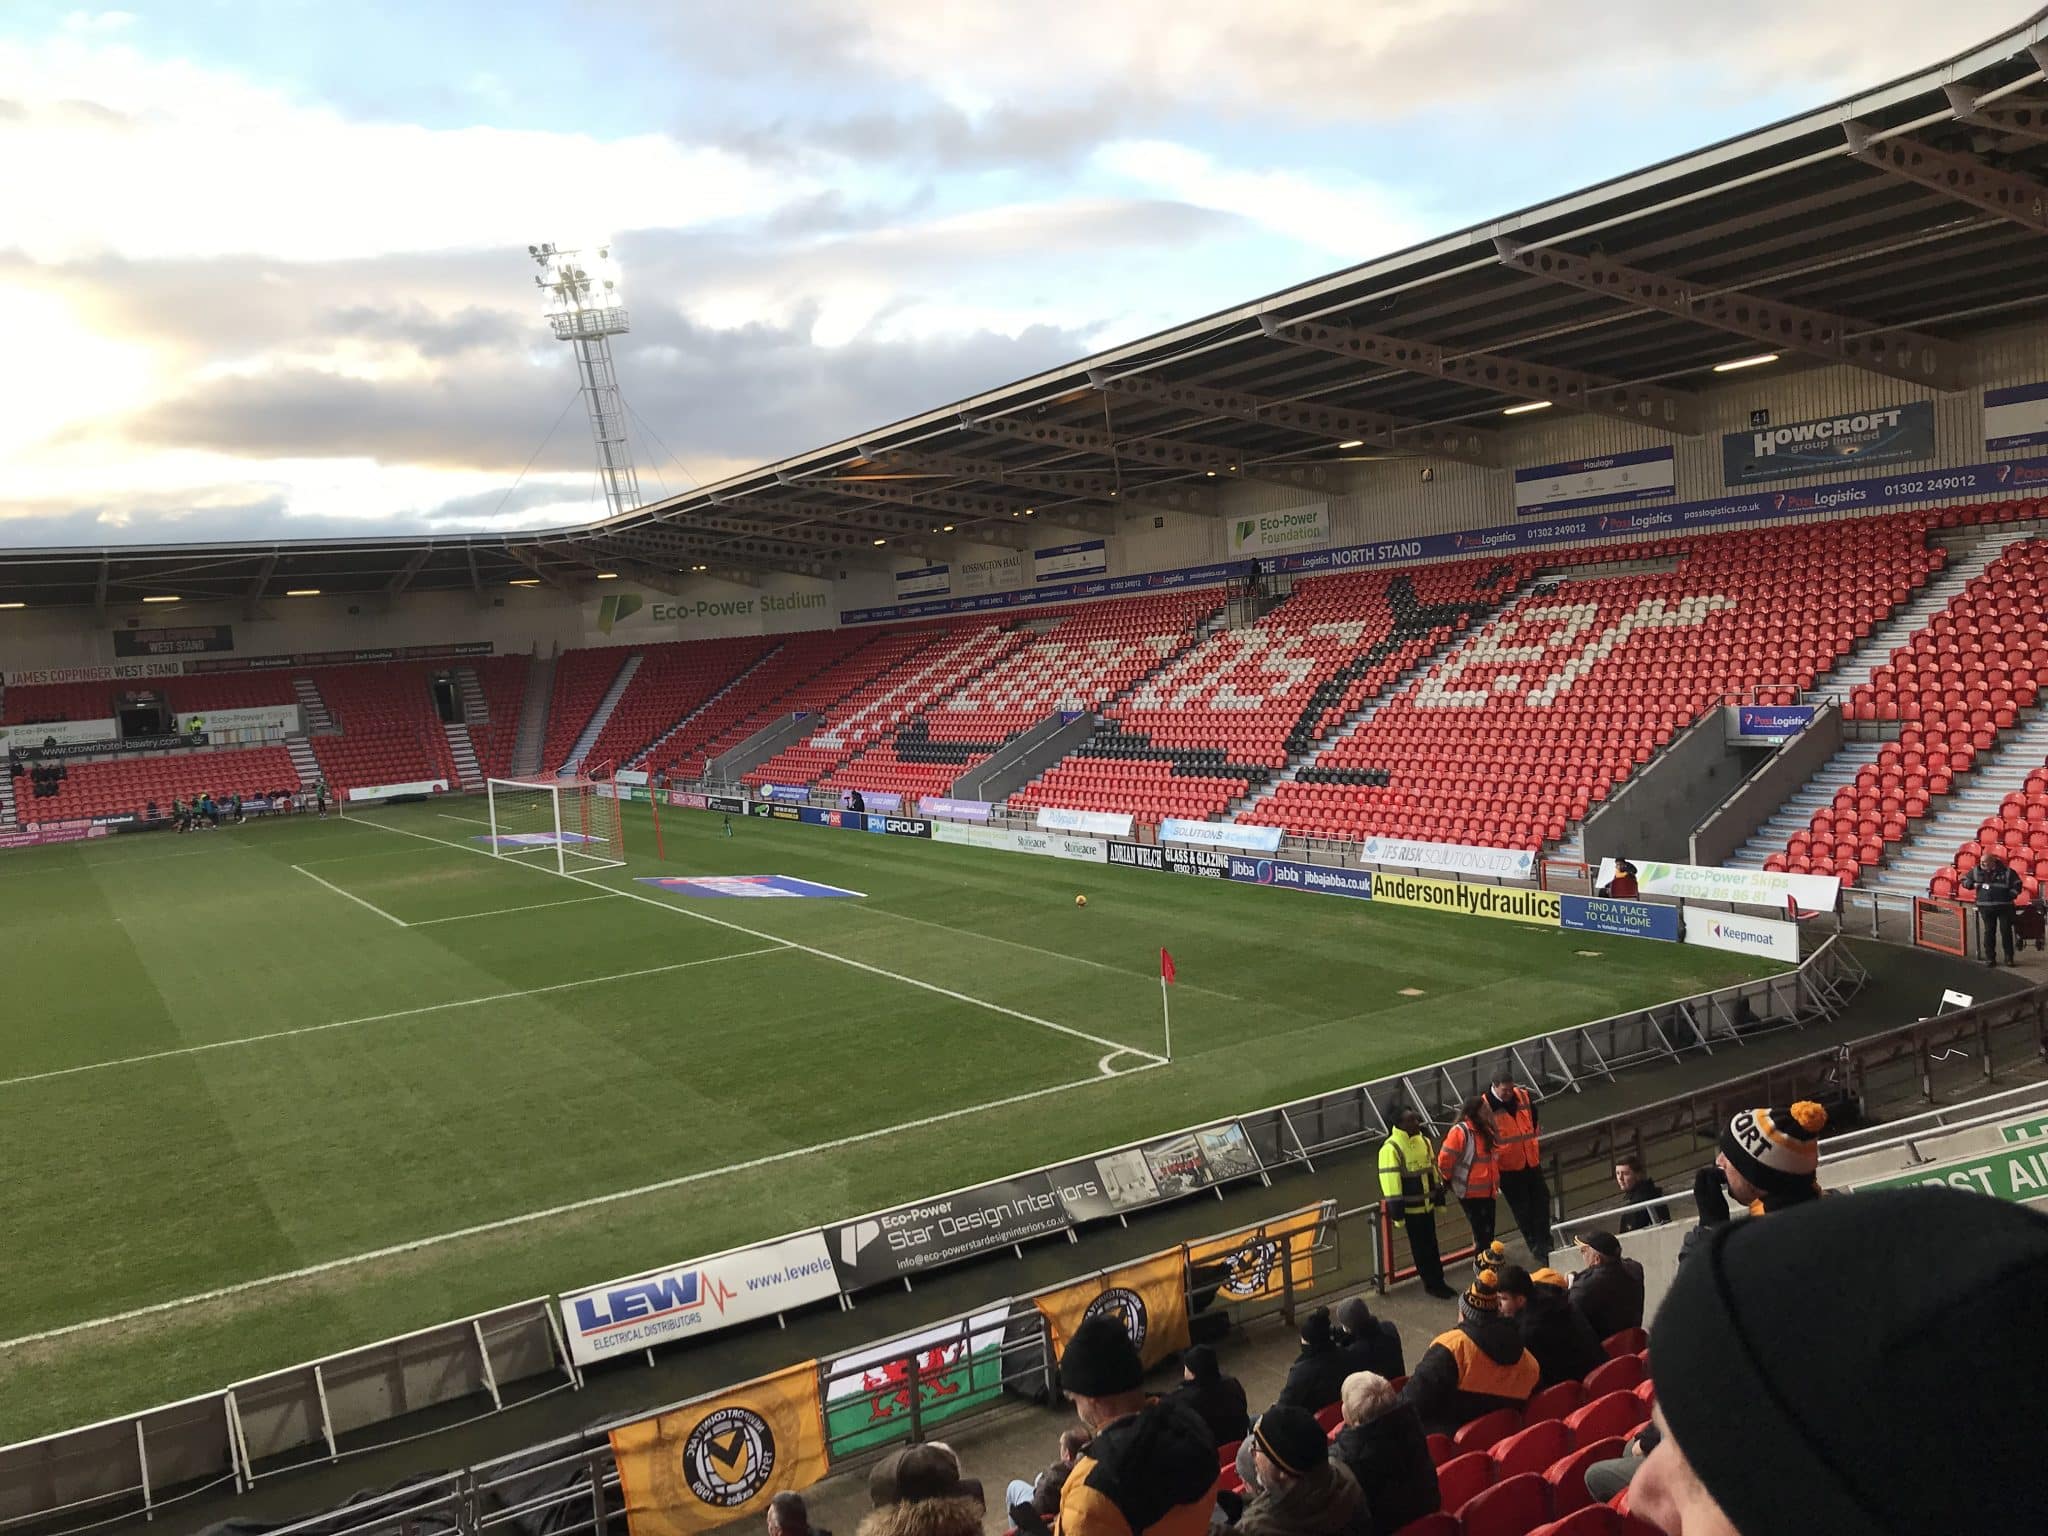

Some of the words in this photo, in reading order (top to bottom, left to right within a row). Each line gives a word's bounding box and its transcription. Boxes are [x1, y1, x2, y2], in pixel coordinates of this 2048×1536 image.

[1753, 412, 1767, 424] 41
[1753, 409, 1902, 458] HOWCROFT
[1790, 437, 1829, 454] group
[1832, 429, 1880, 447] limited
[1884, 482, 1924, 496] 01302
[1927, 475, 1976, 492] 249012
[1260, 511, 1318, 531] Eco-Power
[1684, 502, 1761, 520] passlogistics.co.uk
[1260, 525, 1320, 545] Foundation
[1527, 527, 1553, 539] 01302
[1554, 523, 1586, 536] 249012
[1003, 556, 1021, 567] HALL
[1331, 548, 1375, 565] NORTH
[1378, 542, 1422, 560] STAND
[652, 600, 754, 622] Eco-Power
[759, 590, 827, 613] Stadium
[149, 641, 176, 653] WEST
[176, 640, 205, 652] STAND
[10, 670, 48, 685] JAMES
[50, 667, 112, 682] COPPINGER
[114, 664, 146, 678] WEST
[146, 662, 179, 676] STAND
[14, 726, 68, 736] Eco-Power
[42, 736, 181, 758] www.crownhotel-bawtry.com
[886, 821, 924, 834] GROUP
[1172, 826, 1223, 840] SOLUTIONS
[1064, 840, 1096, 856] Stoneacre
[1110, 842, 1136, 866] ADRIAN
[1137, 848, 1162, 869] WELCH
[1164, 848, 1188, 864] GLASS
[1189, 852, 1195, 864] &
[1196, 853, 1229, 868] GLAZING
[1398, 846, 1424, 862] RISK
[1424, 848, 1487, 871] SOLUTIONS
[1488, 854, 1512, 871] LTD
[1174, 864, 1190, 874] 01302
[1197, 866, 1220, 878] 304555
[1304, 870, 1370, 891] jibbajabba.co.uk
[1675, 868, 1748, 885] Eco-Power
[1750, 874, 1788, 889] Skips
[1373, 874, 1459, 906] Anderson
[1457, 884, 1560, 919] Hydraulics
[1671, 884, 1708, 898] 01302
[1732, 890, 1749, 901] 86
[1585, 911, 1598, 922] TO
[1600, 912, 1621, 924] CALL
[1623, 915, 1651, 928] HOME
[1588, 902, 1609, 914] FIND
[1610, 904, 1618, 914] A
[1620, 904, 1648, 918] PLACE
[1723, 926, 1774, 946] Keepmoat
[1735, 1110, 1772, 1158] ORT
[880, 1200, 952, 1230] Eco-Power
[887, 1226, 935, 1250] Star
[940, 1204, 1012, 1236] Design
[1012, 1180, 1098, 1216] Interiors
[574, 1272, 698, 1332] LEW
[746, 1256, 832, 1292] www.lewele
[594, 1326, 644, 1350] ELECTRICAL
[644, 1310, 702, 1337] DISTRIBUTORS
